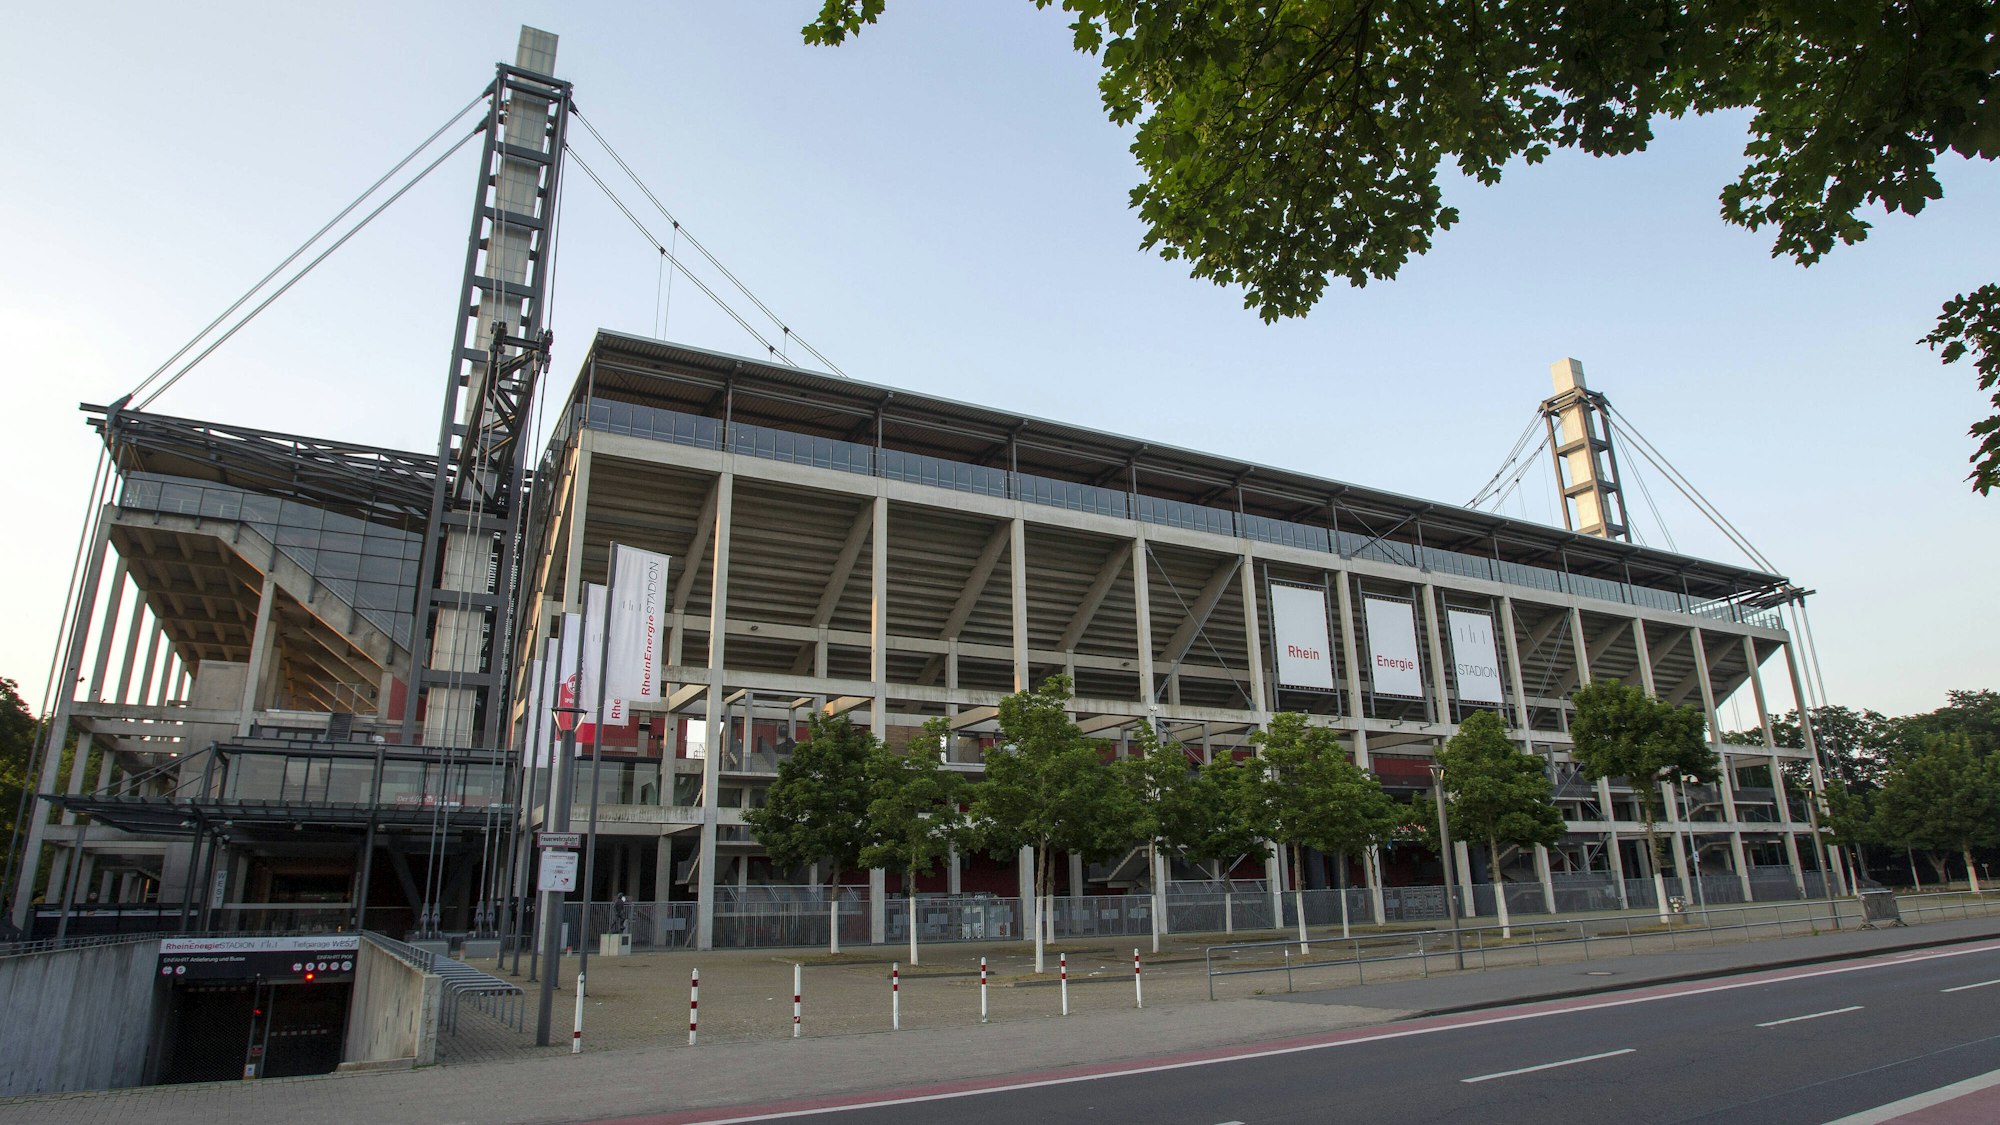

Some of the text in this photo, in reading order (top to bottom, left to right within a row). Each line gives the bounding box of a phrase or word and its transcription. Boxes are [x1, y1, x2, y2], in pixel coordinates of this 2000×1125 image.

[641, 561, 659, 696] RheinEnergieSTADION
[1287, 645, 1320, 661] Rhein
[1376, 655, 1414, 670] Energie
[1457, 663, 1498, 679] STADION
[611, 698, 621, 719] Rhe
[216, 873, 226, 902] WEST
[166, 942, 255, 951] RheinEnergieSTADION
[293, 941, 330, 949] Tiefgarage
